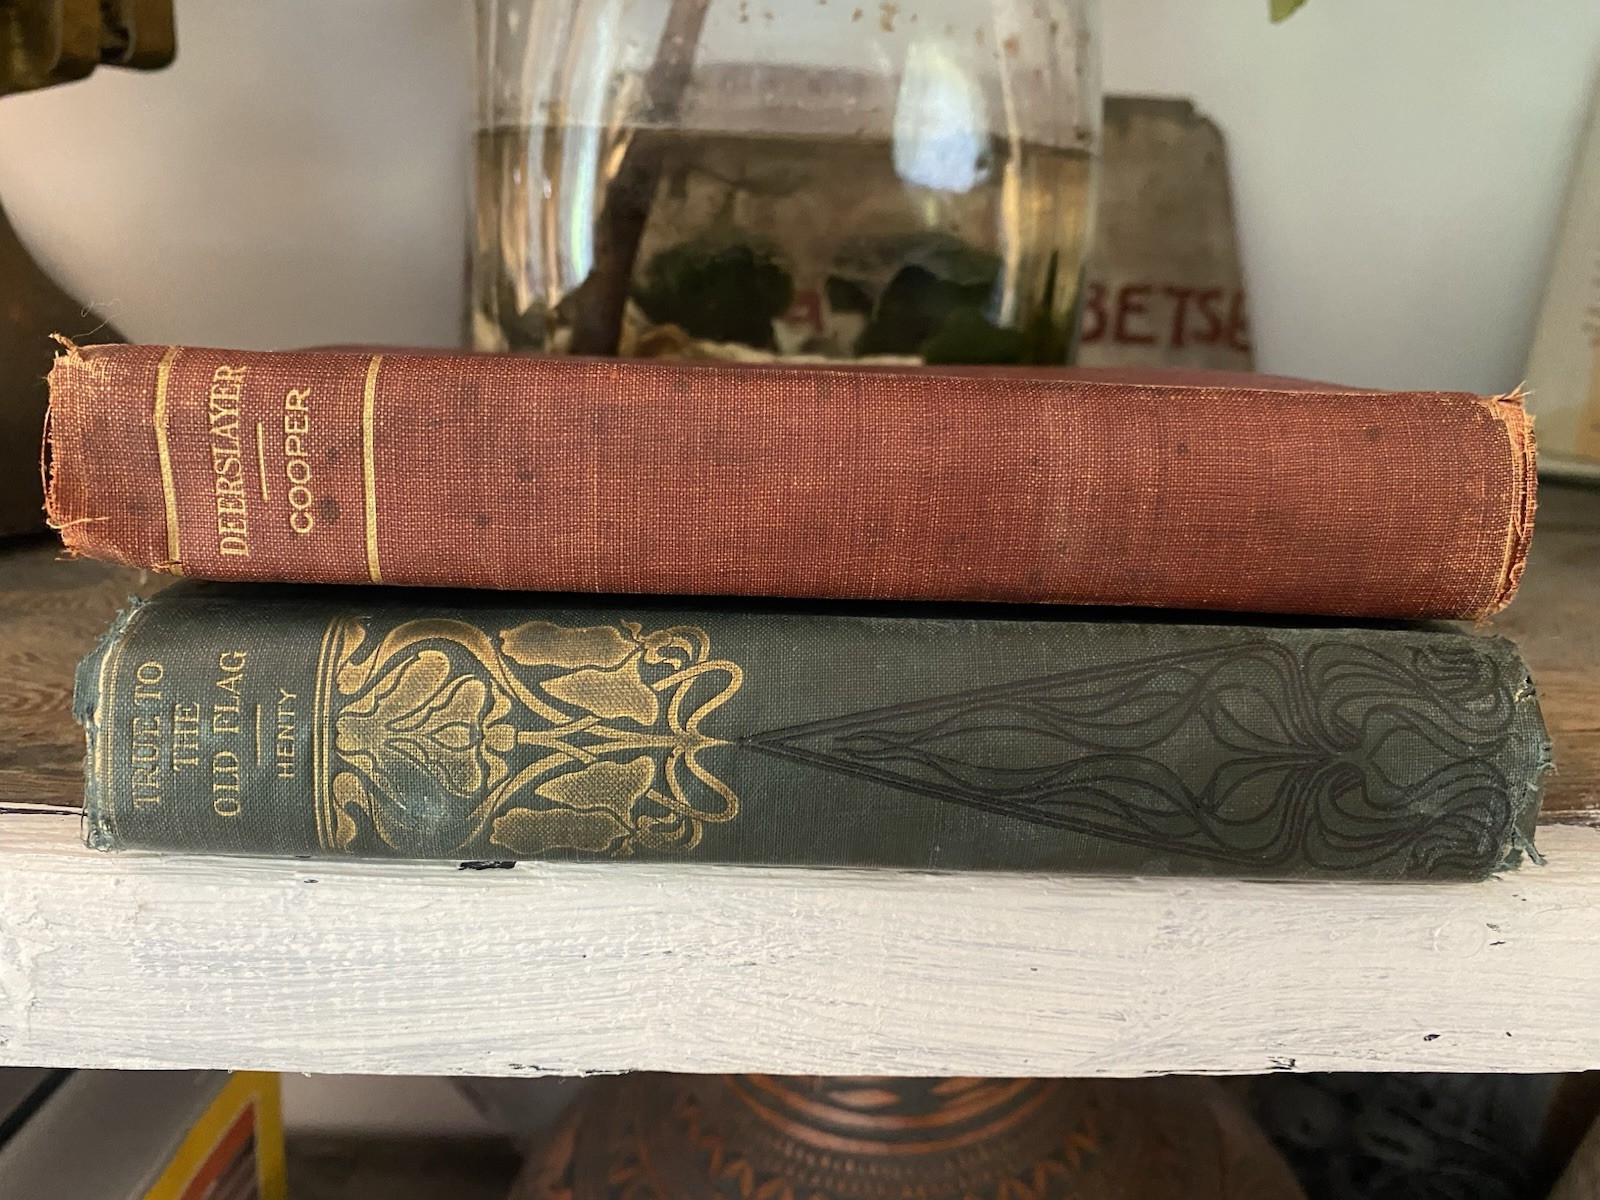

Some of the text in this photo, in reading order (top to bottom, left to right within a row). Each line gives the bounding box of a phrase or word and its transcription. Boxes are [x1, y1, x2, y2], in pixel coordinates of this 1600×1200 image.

[208, 364, 249, 557] DEERSLAYER
[284, 386, 315, 534] COOPER
[131, 660, 164, 809] TRUE TO
[172, 701, 200, 772] THE
[212, 650, 248, 817] OLD FLAG
[276, 687, 297, 778] HENTY
